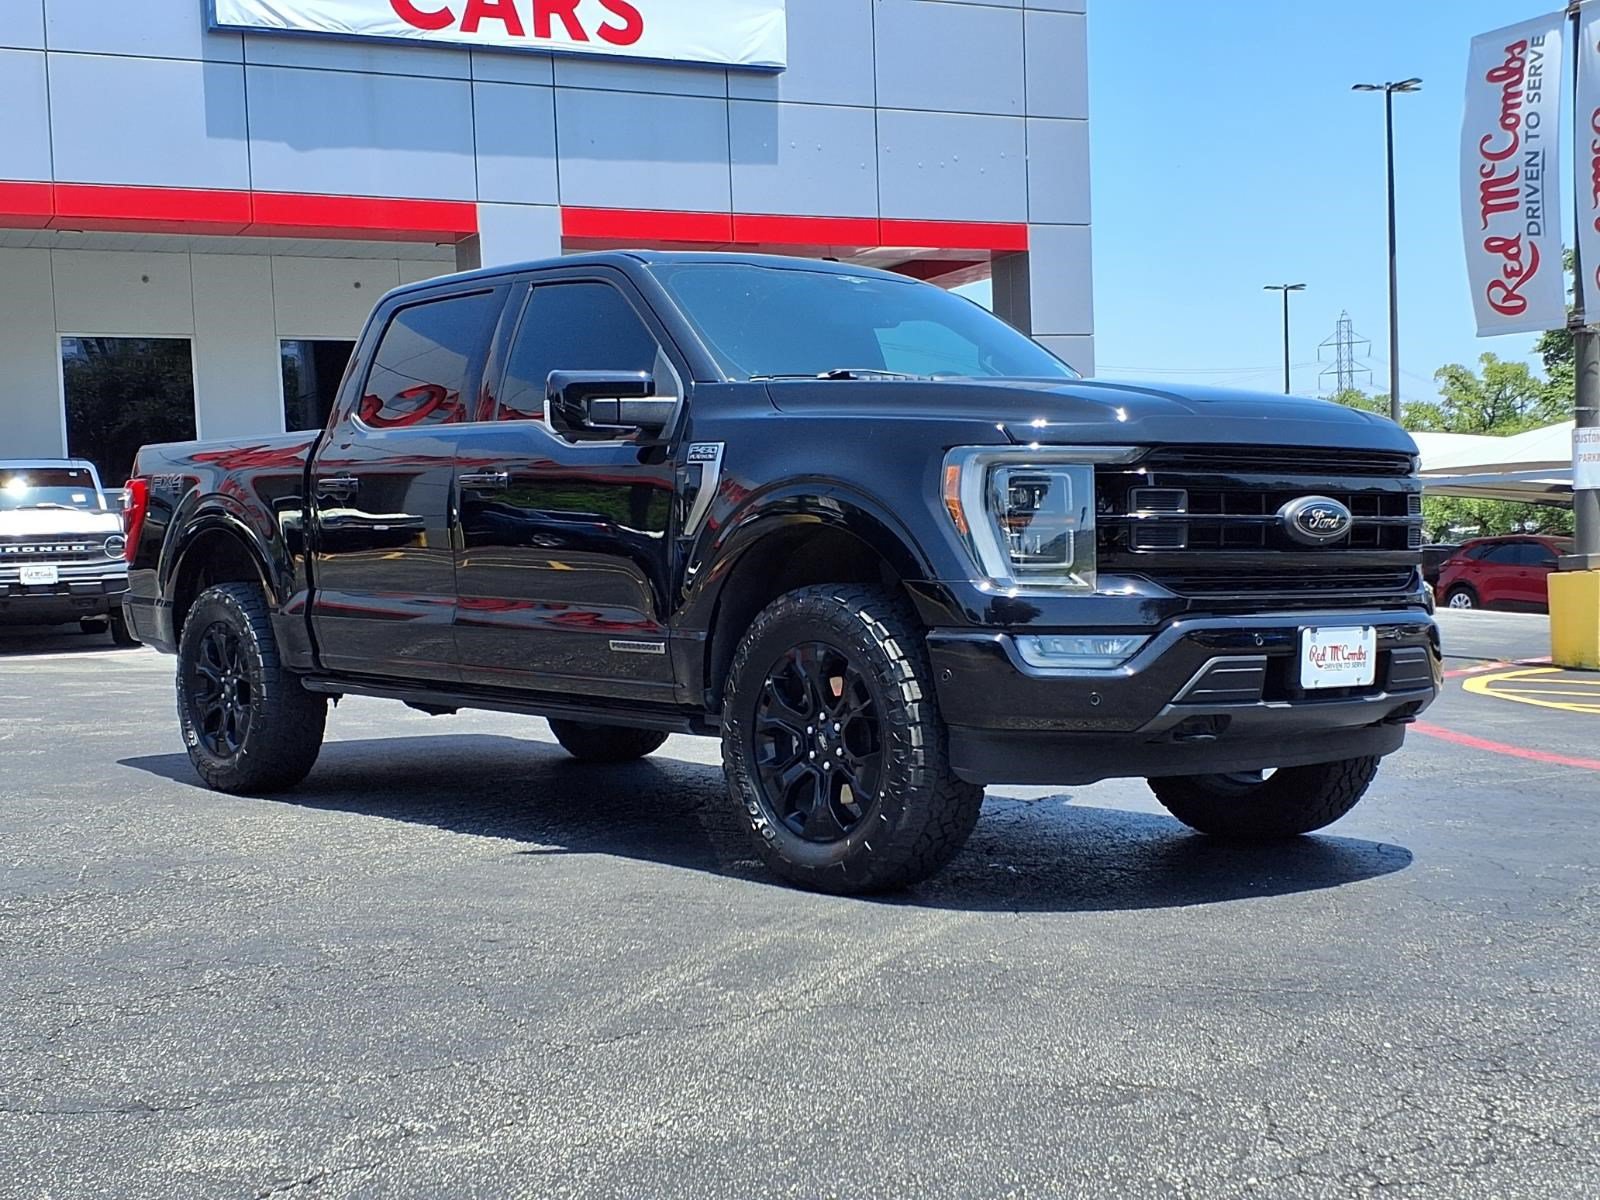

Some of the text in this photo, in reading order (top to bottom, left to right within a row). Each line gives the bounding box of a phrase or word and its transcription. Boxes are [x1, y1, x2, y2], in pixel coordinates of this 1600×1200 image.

[1524, 34, 1546, 237] DRIVEN TO SERVE
[1485, 232, 1540, 316] Red
[151, 473, 184, 495] FX4
[1309, 508, 1339, 529] Ford
[0, 545, 86, 553] RONCO
[1309, 645, 1327, 668] Red
[1323, 662, 1343, 670] DRIVEN
[1351, 661, 1367, 669] SERVE
